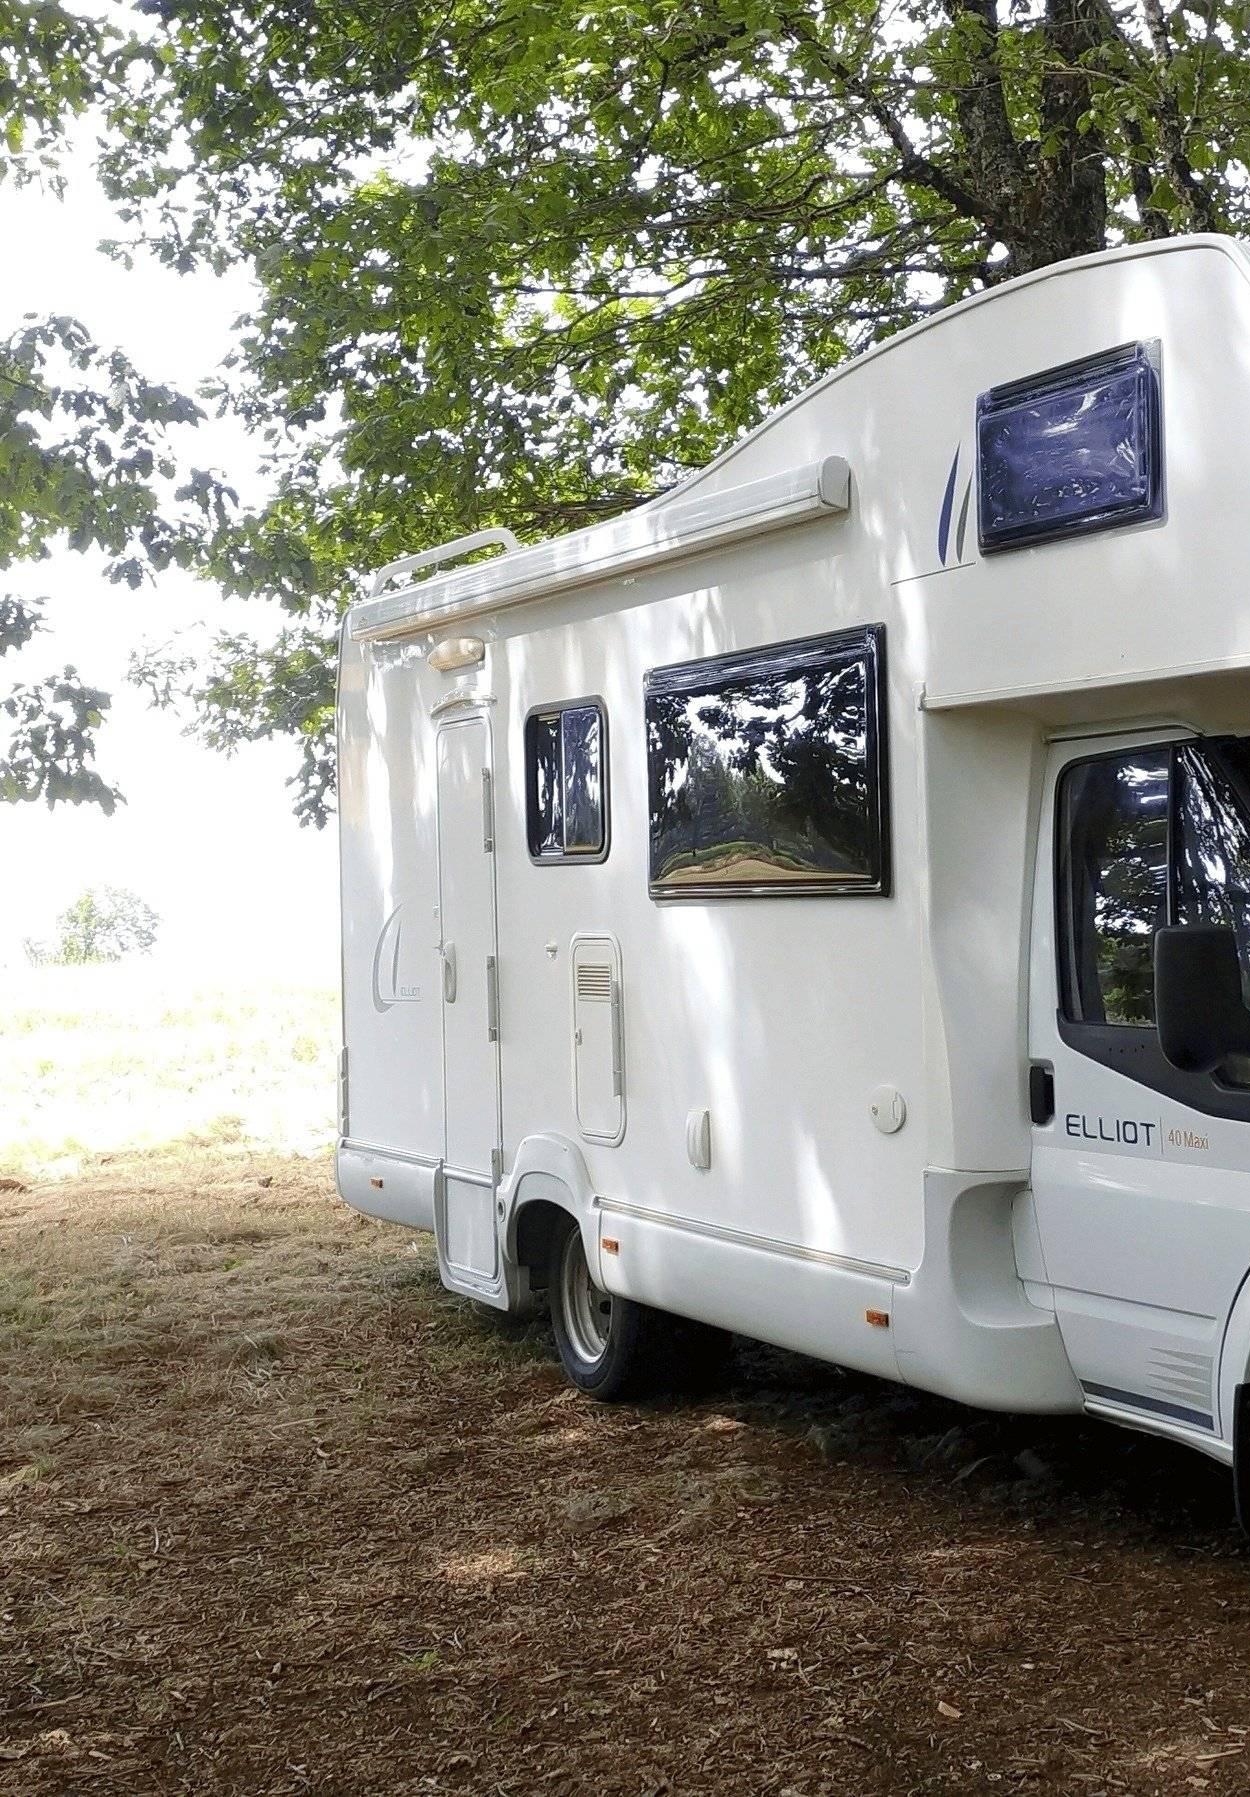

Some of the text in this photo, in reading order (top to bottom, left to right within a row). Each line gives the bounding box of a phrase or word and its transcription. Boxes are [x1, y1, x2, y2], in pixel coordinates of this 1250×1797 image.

[1066, 1113, 1209, 1150] ELLIOT 40 Maxi
